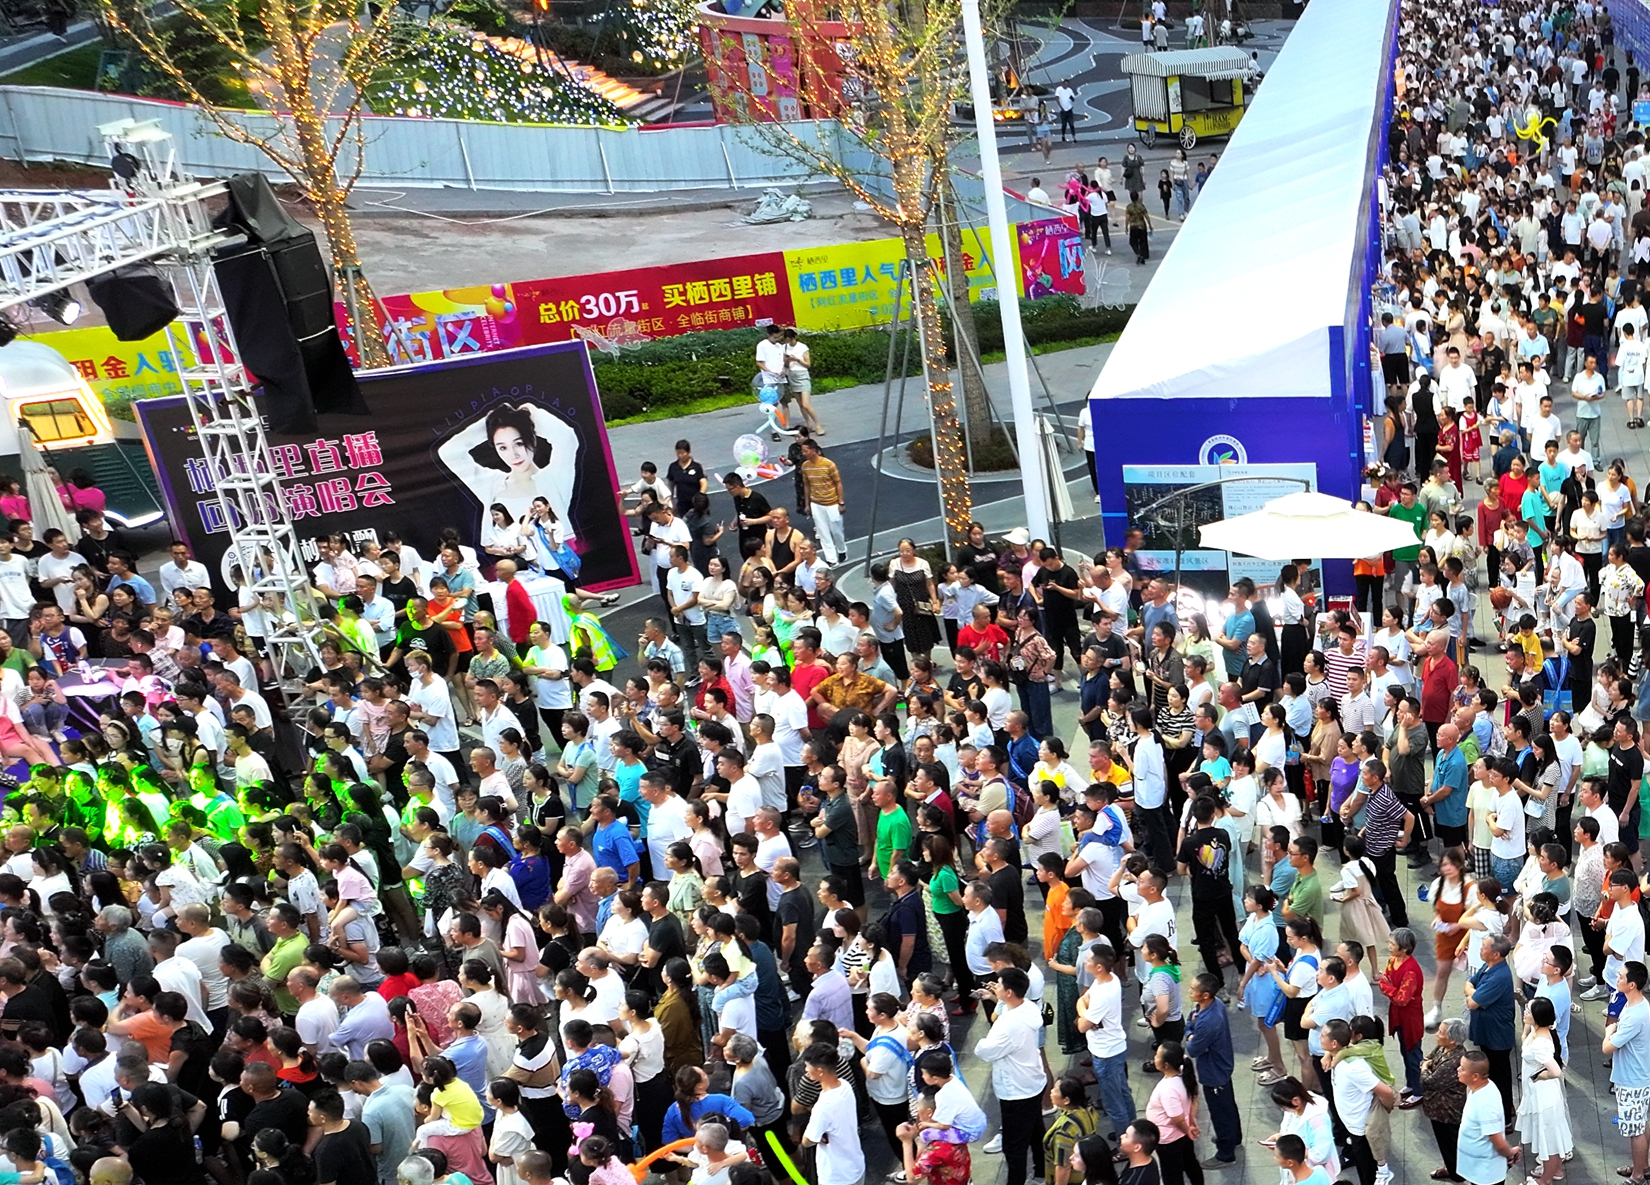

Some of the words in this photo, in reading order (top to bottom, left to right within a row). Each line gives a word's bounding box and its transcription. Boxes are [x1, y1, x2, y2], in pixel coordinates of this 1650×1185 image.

[661, 272, 778, 310] 买栖西里铺
